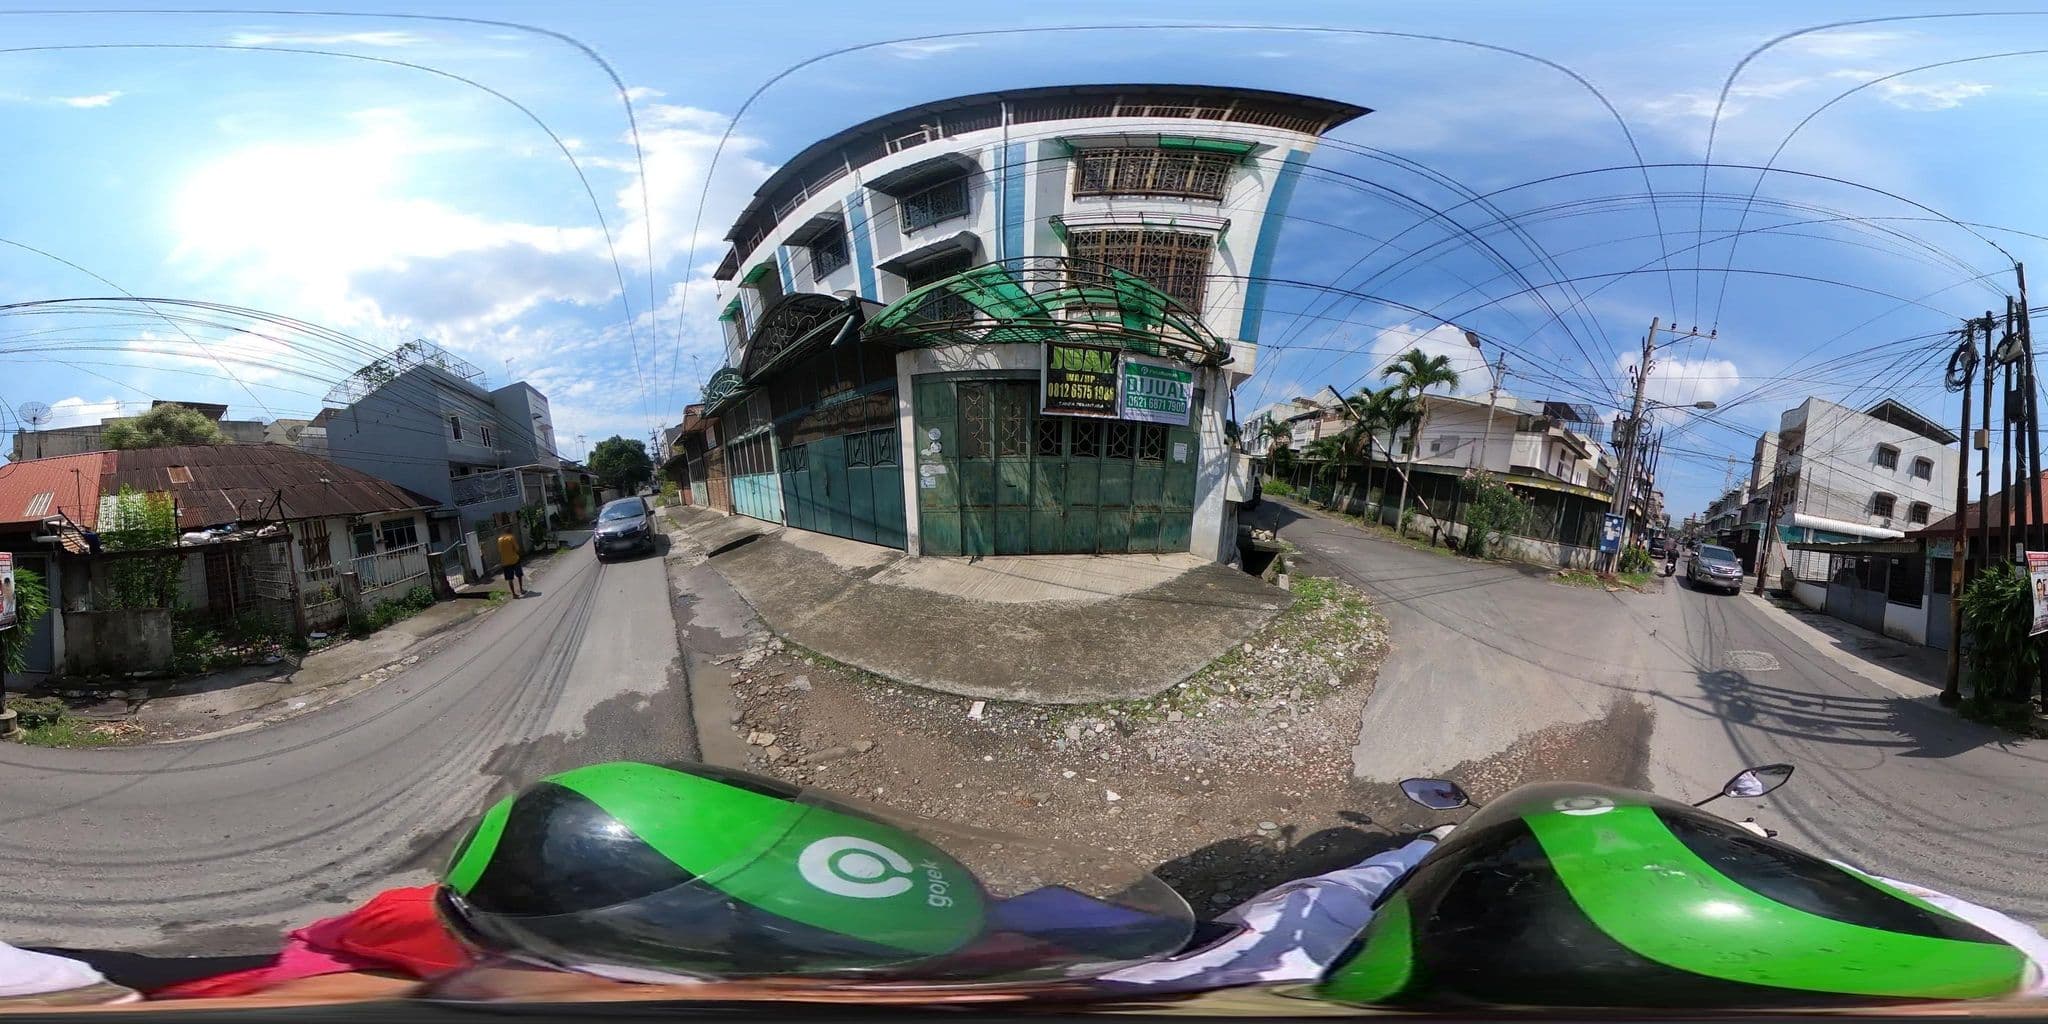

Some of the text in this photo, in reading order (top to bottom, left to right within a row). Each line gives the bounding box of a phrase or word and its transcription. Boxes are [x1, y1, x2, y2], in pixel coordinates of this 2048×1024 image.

[1048, 383, 1070, 398] 0812
[1071, 384, 1093, 399] 6575
[1127, 376, 1187, 399] DIJUAL
[1148, 397, 1166, 410] 6871
[920, 858, 954, 908] gojek
